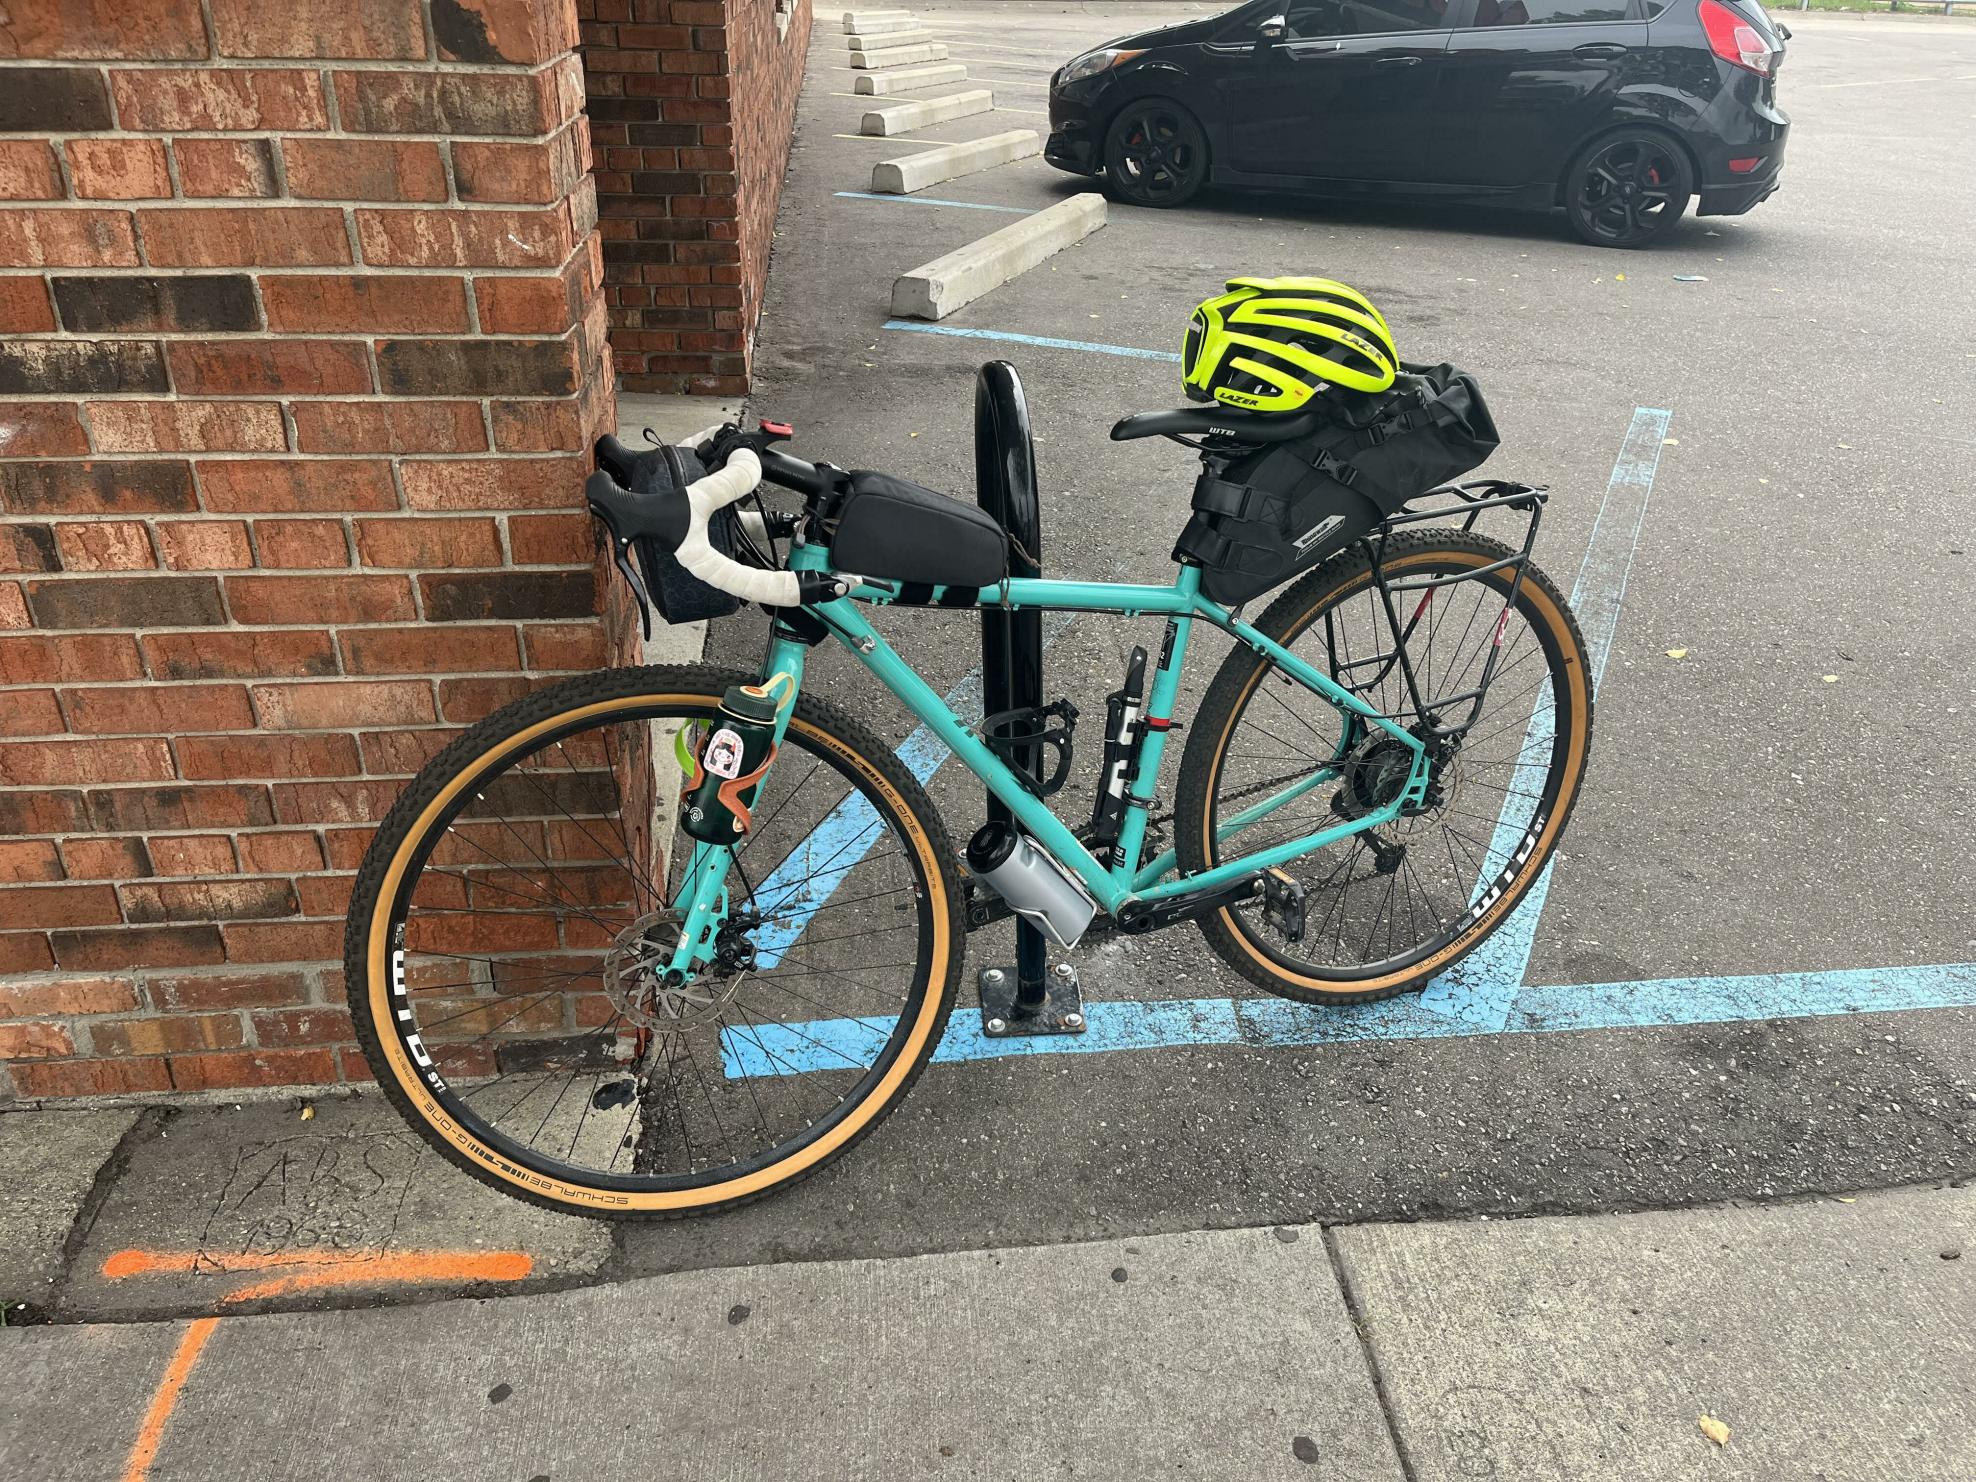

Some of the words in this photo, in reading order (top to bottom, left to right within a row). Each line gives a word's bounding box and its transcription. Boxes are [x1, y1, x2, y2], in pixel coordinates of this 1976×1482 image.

[1340, 333, 1384, 361] LAZER
[1219, 392, 1259, 406] LAZER
[1208, 427, 1237, 436] WTB
[1491, 846, 1542, 913] SCHWALBE
[1414, 945, 1452, 970] G-ONE
[393, 1047, 426, 1100] ULTRABITE
[427, 1071, 445, 1089] ST
[423, 1101, 468, 1144] G-ONE
[526, 1175, 628, 1204] SCHWALBE
